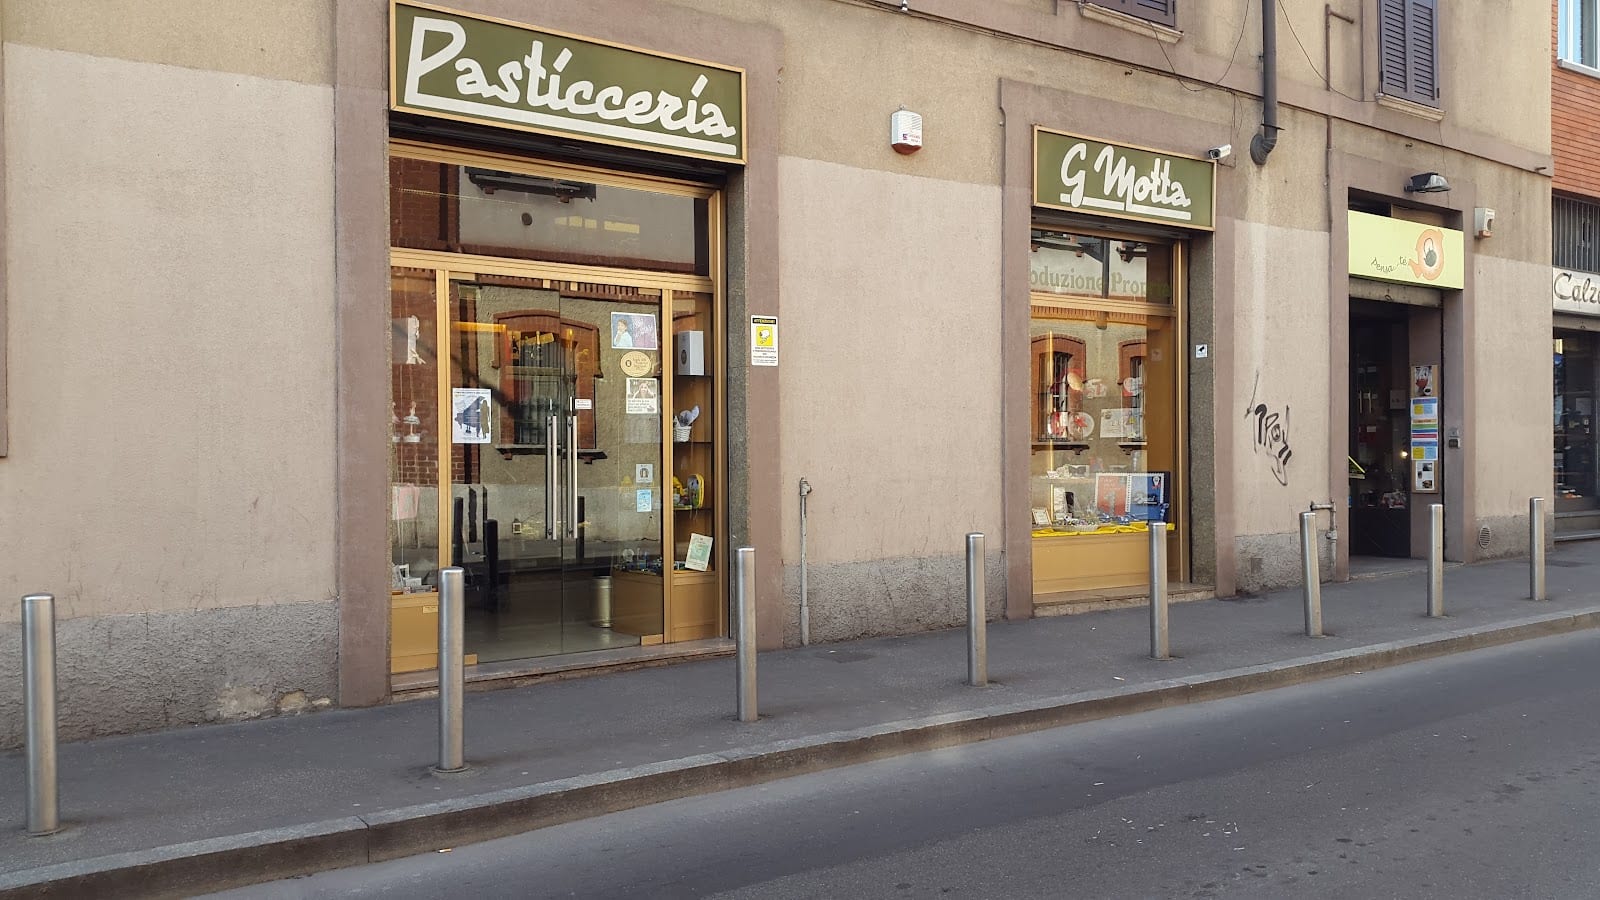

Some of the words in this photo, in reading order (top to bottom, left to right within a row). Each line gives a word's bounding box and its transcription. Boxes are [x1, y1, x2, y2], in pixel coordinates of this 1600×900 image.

[404, 16, 737, 140] Pasticceria
[1060, 142, 1087, 208] G
[1093, 145, 1192, 210] Motta
